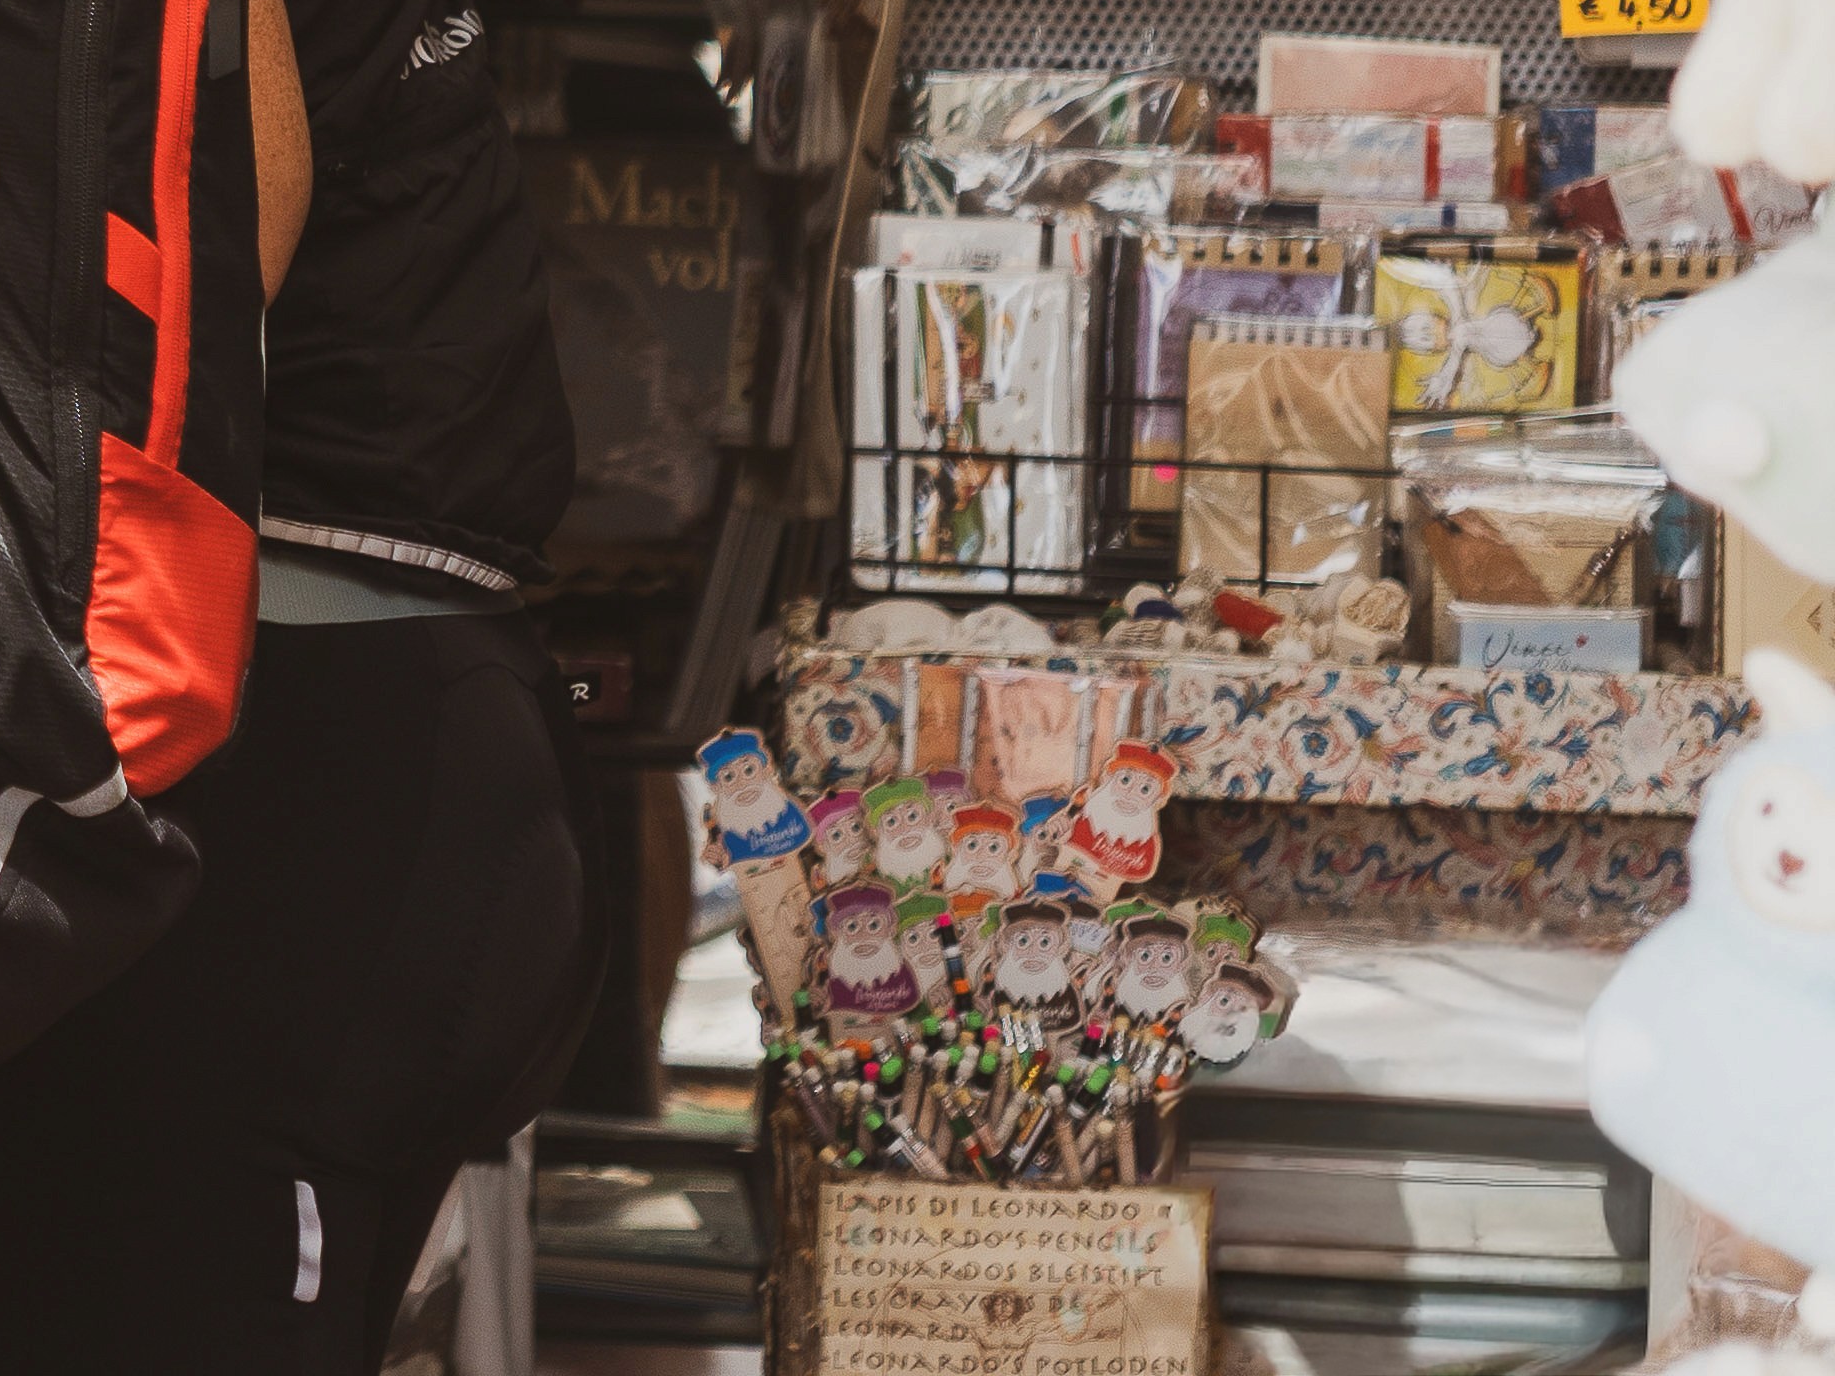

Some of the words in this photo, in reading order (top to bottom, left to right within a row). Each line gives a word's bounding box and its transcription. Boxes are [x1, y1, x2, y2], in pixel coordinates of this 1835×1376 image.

[928, 1197, 959, 1218] DI
[972, 1196, 1141, 1223] LEONARDO
[1036, 1353, 1188, 1376] POTLODEN
